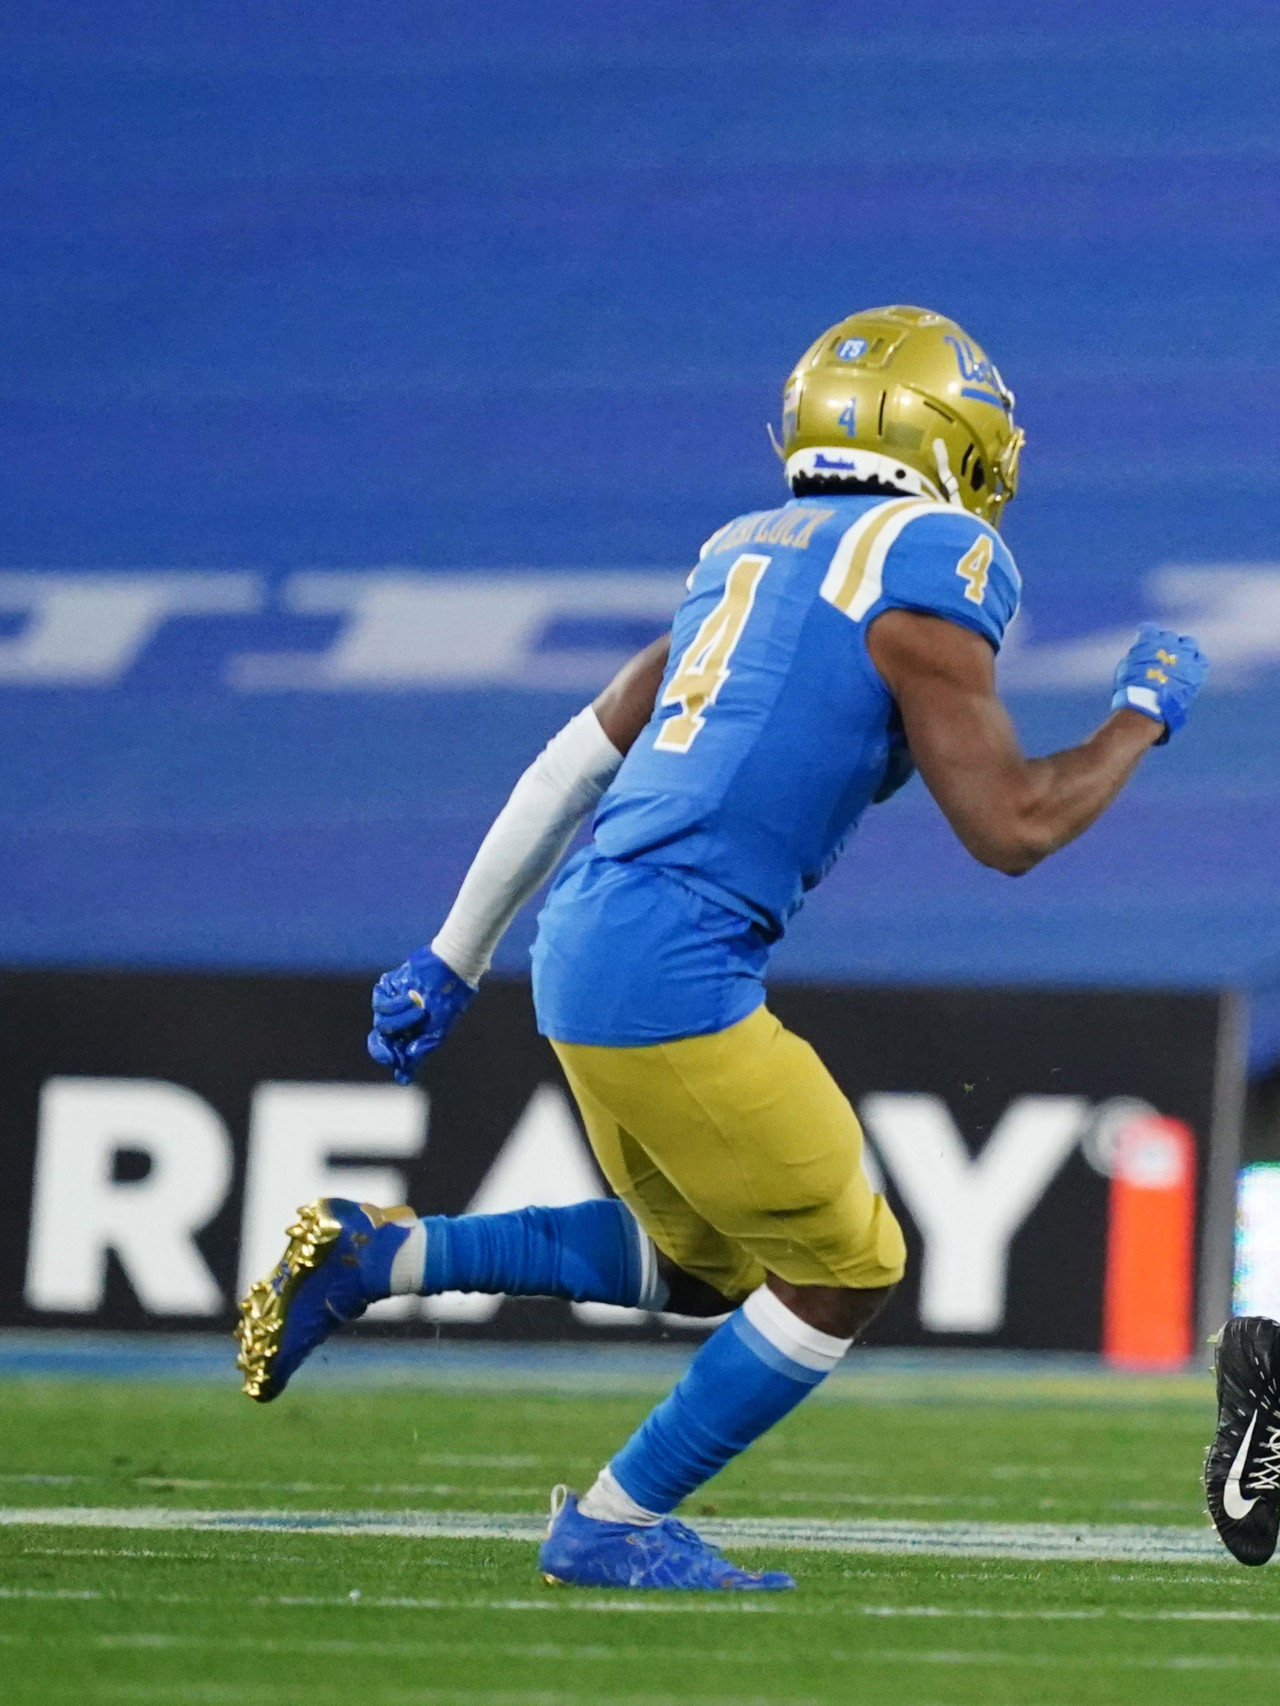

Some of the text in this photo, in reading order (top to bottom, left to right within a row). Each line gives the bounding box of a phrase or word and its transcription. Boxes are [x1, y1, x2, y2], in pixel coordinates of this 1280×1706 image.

[837, 396, 857, 438] 4
[956, 533, 994, 606] 4
[653, 553, 772, 753] 4
[24, 1075, 1092, 1334] REAY
